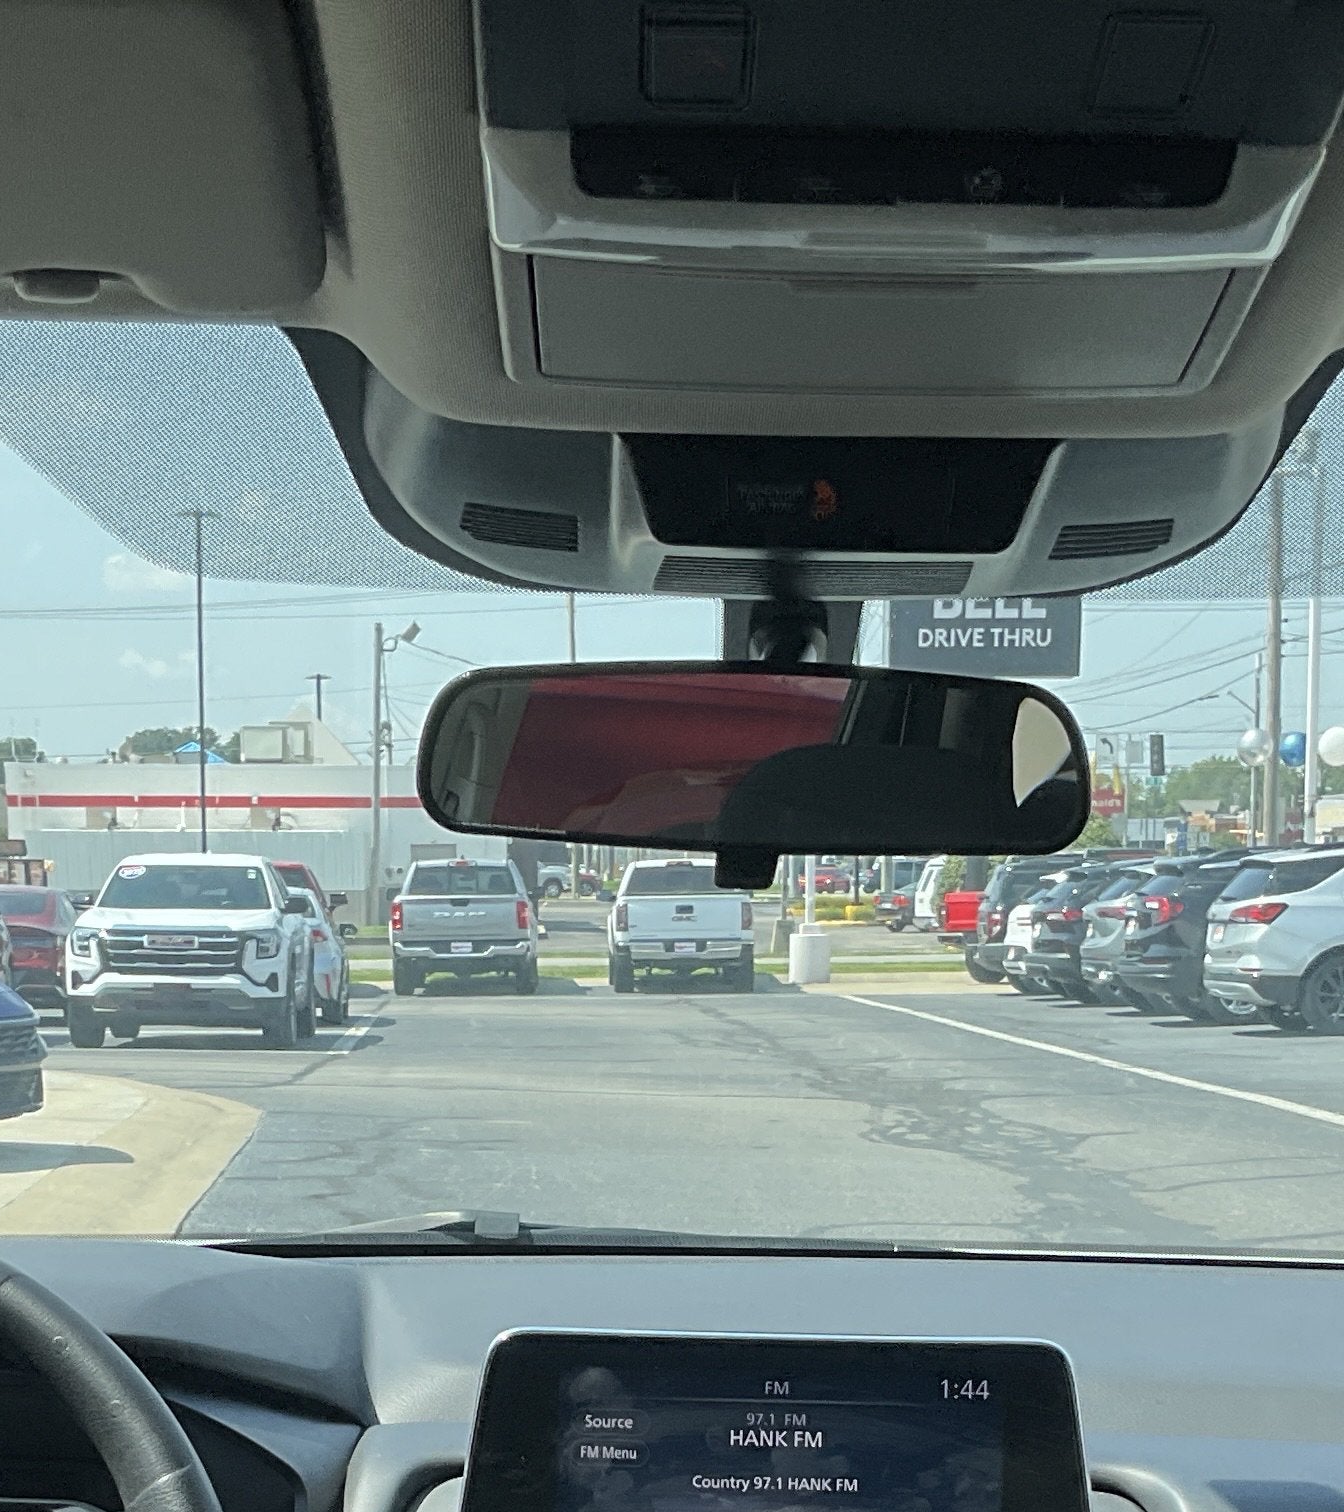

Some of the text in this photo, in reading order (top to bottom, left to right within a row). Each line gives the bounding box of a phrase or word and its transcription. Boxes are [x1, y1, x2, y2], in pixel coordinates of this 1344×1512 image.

[918, 628, 1052, 648] DRIVE THRU
[764, 1381, 789, 1395] FM
[939, 1378, 990, 1400] 1:44
[584, 1414, 634, 1430] Source
[746, 1413, 806, 1427] 97.1 FM
[729, 1430, 823, 1448] HANK FM
[580, 1446, 637, 1459] FM Menu
[692, 1475, 858, 1492] Country 97.1 HANK FM
